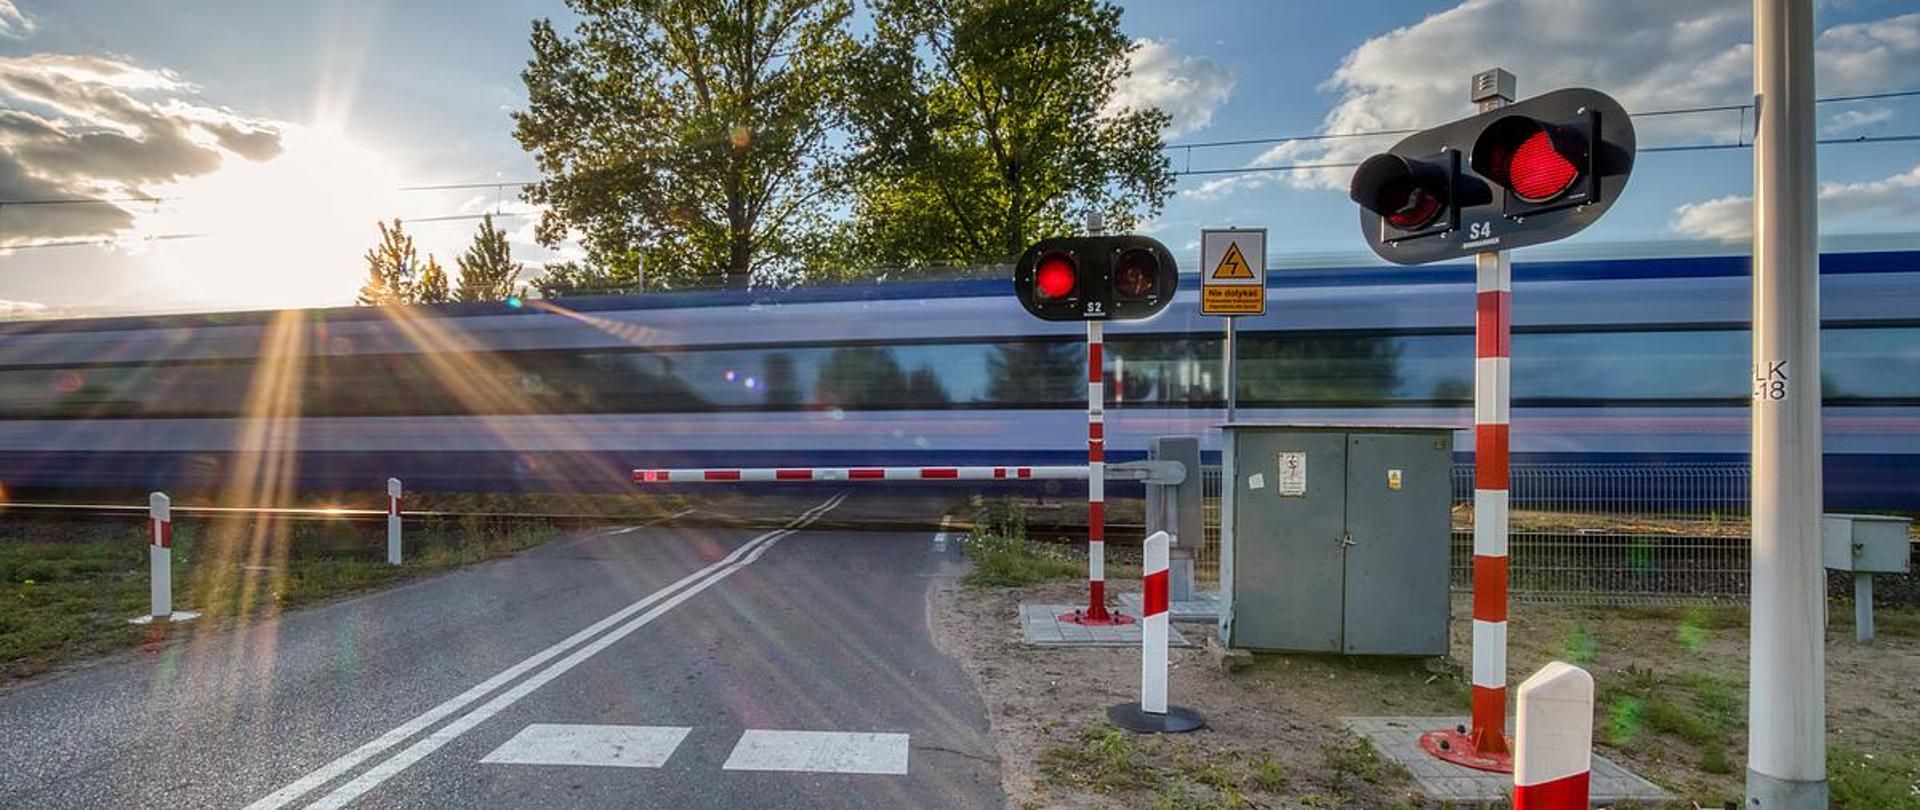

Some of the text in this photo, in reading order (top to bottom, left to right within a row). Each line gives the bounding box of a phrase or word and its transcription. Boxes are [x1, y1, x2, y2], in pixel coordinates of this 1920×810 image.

[1469, 221, 1491, 240] S4
[1208, 289, 1222, 297] Nie
[1087, 301, 1102, 312] S2
[1756, 360, 1788, 381] LK
